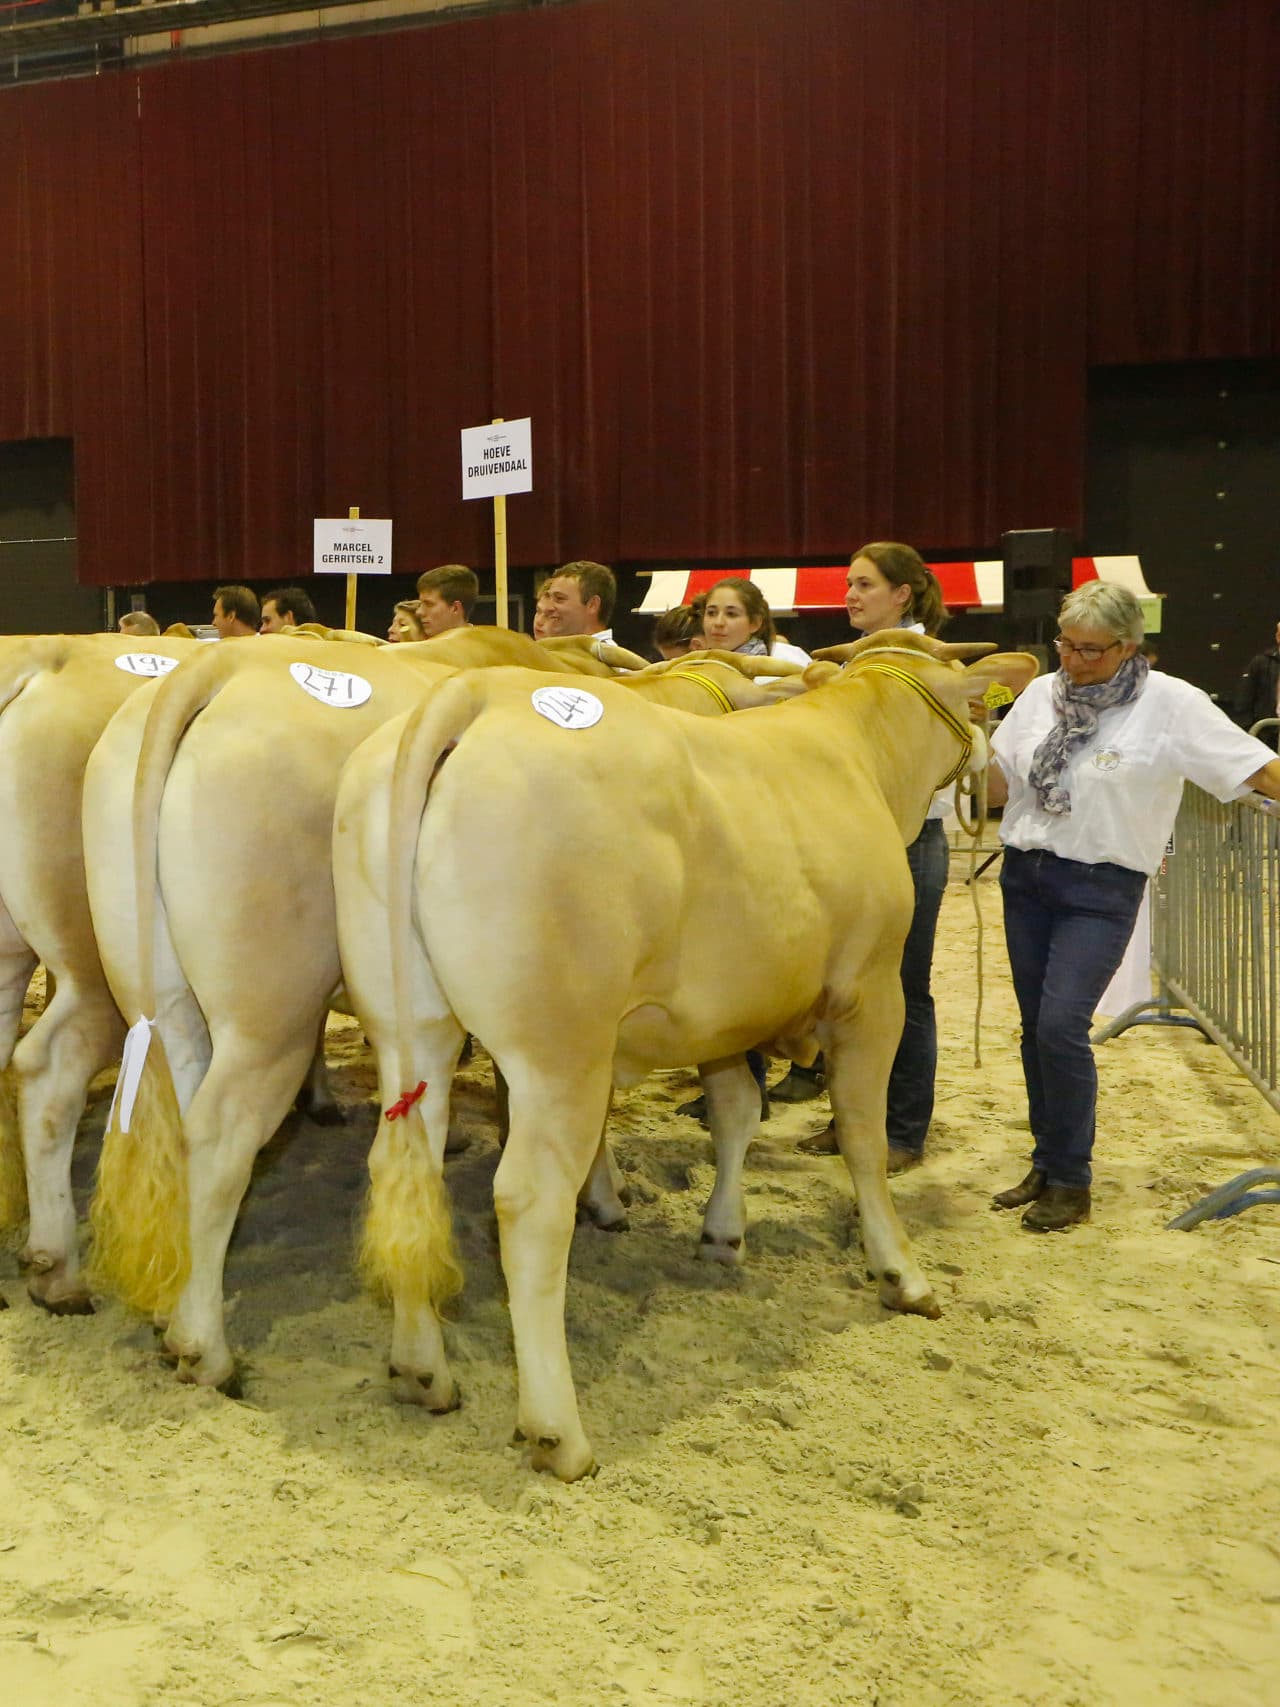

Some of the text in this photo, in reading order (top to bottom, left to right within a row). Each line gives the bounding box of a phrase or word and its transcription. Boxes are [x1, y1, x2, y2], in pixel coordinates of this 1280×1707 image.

[483, 445, 511, 460] HOEVE
[468, 458, 528, 478] DRUIVENDAAL
[333, 543, 373, 552] MARCEL
[322, 554, 384, 564] GERRITSEN 2
[296, 663, 353, 700] 271
[537, 690, 589, 723] 244
